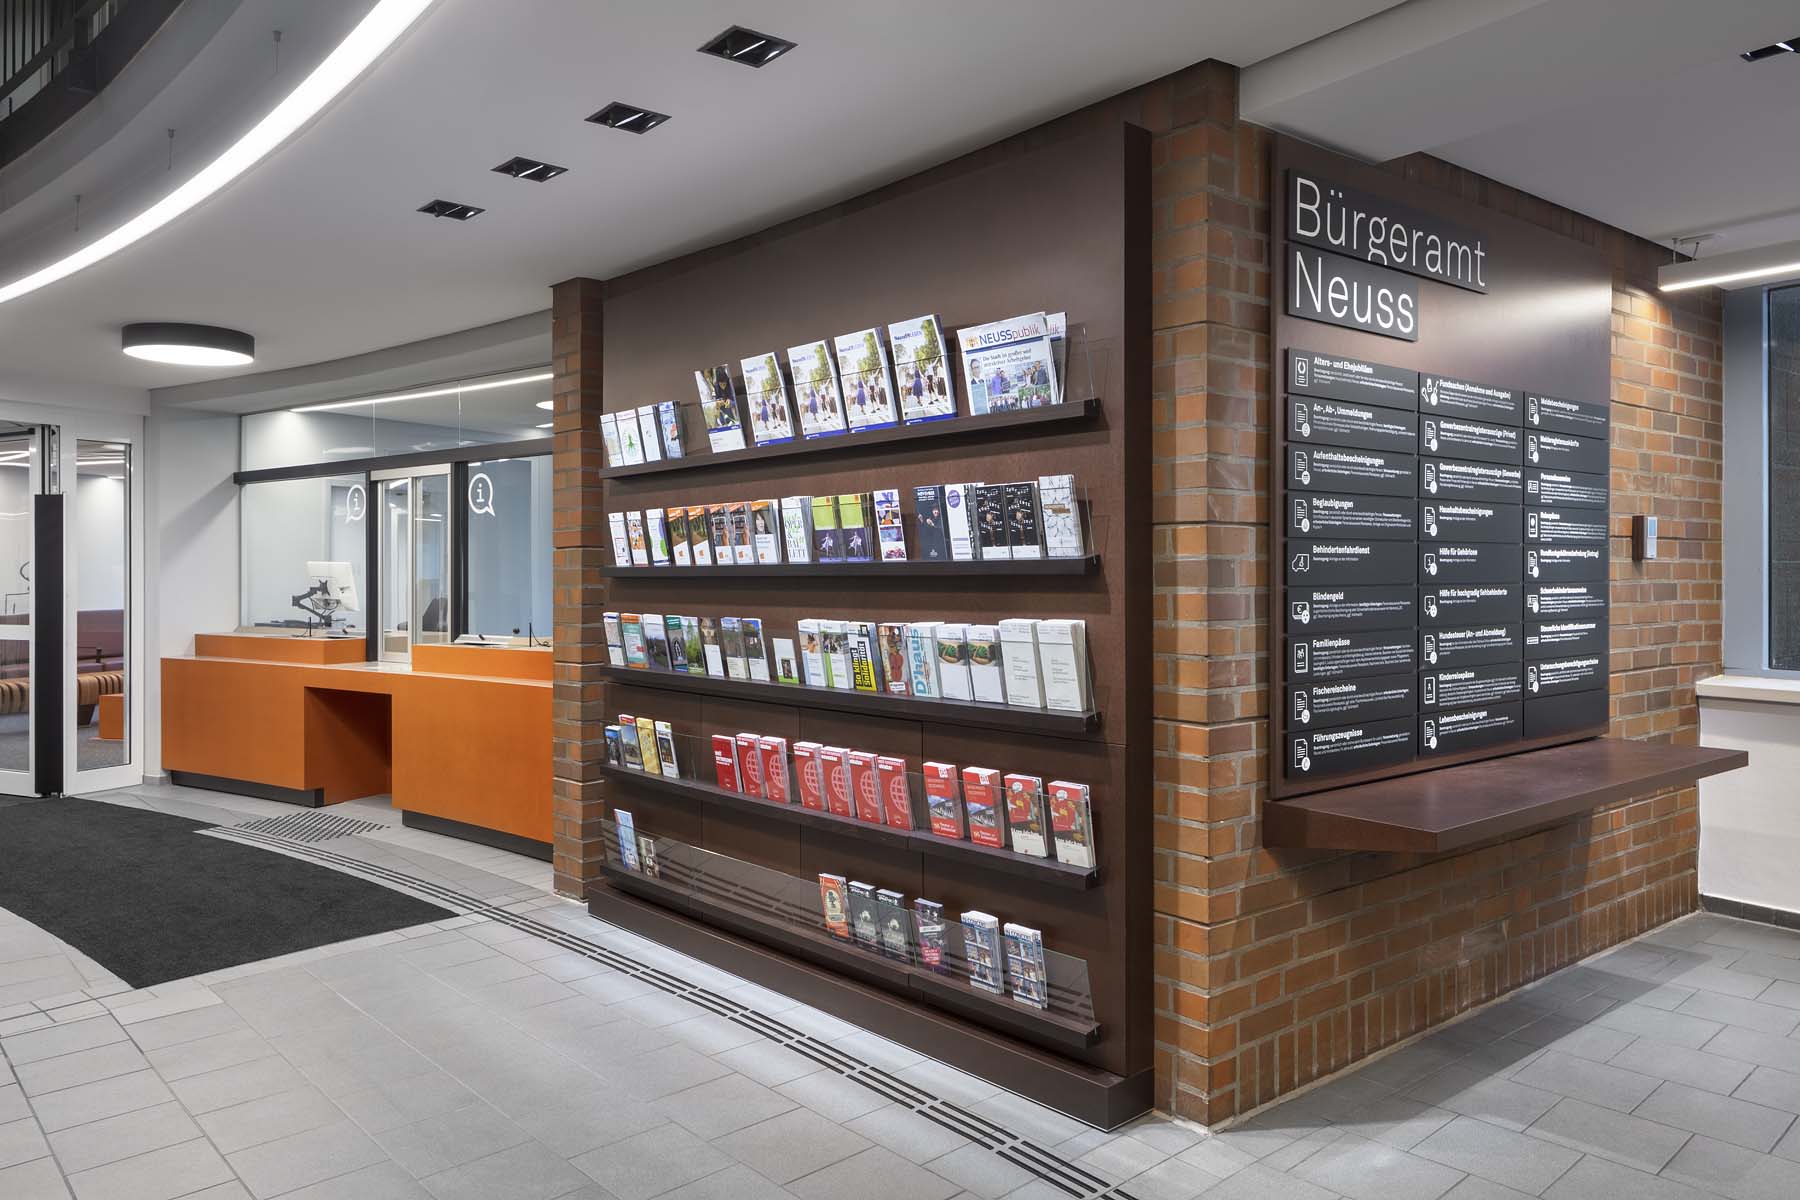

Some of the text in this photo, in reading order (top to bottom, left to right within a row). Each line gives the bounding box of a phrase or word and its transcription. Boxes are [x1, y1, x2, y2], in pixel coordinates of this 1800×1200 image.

[1296, 177, 1486, 287] Bürgeramt
[1295, 251, 1413, 333] Neuss
[979, 323, 1041, 346] NEUSSpublik
[1314, 356, 1332, 367] Alters-
[1333, 361, 1344, 369] und
[1337, 406, 1373, 420] Ummeldungen
[1312, 498, 1354, 510] Beglaubigungen
[1312, 545, 1370, 554] Behindertenfahrdienst
[1312, 592, 1344, 602] Blindengeld
[1312, 638, 1350, 648] Familienpässe
[850, 648, 863, 687] So klingt
[859, 642, 871, 688] Solidarität
[1313, 728, 1363, 743] Führungszeugnisse
